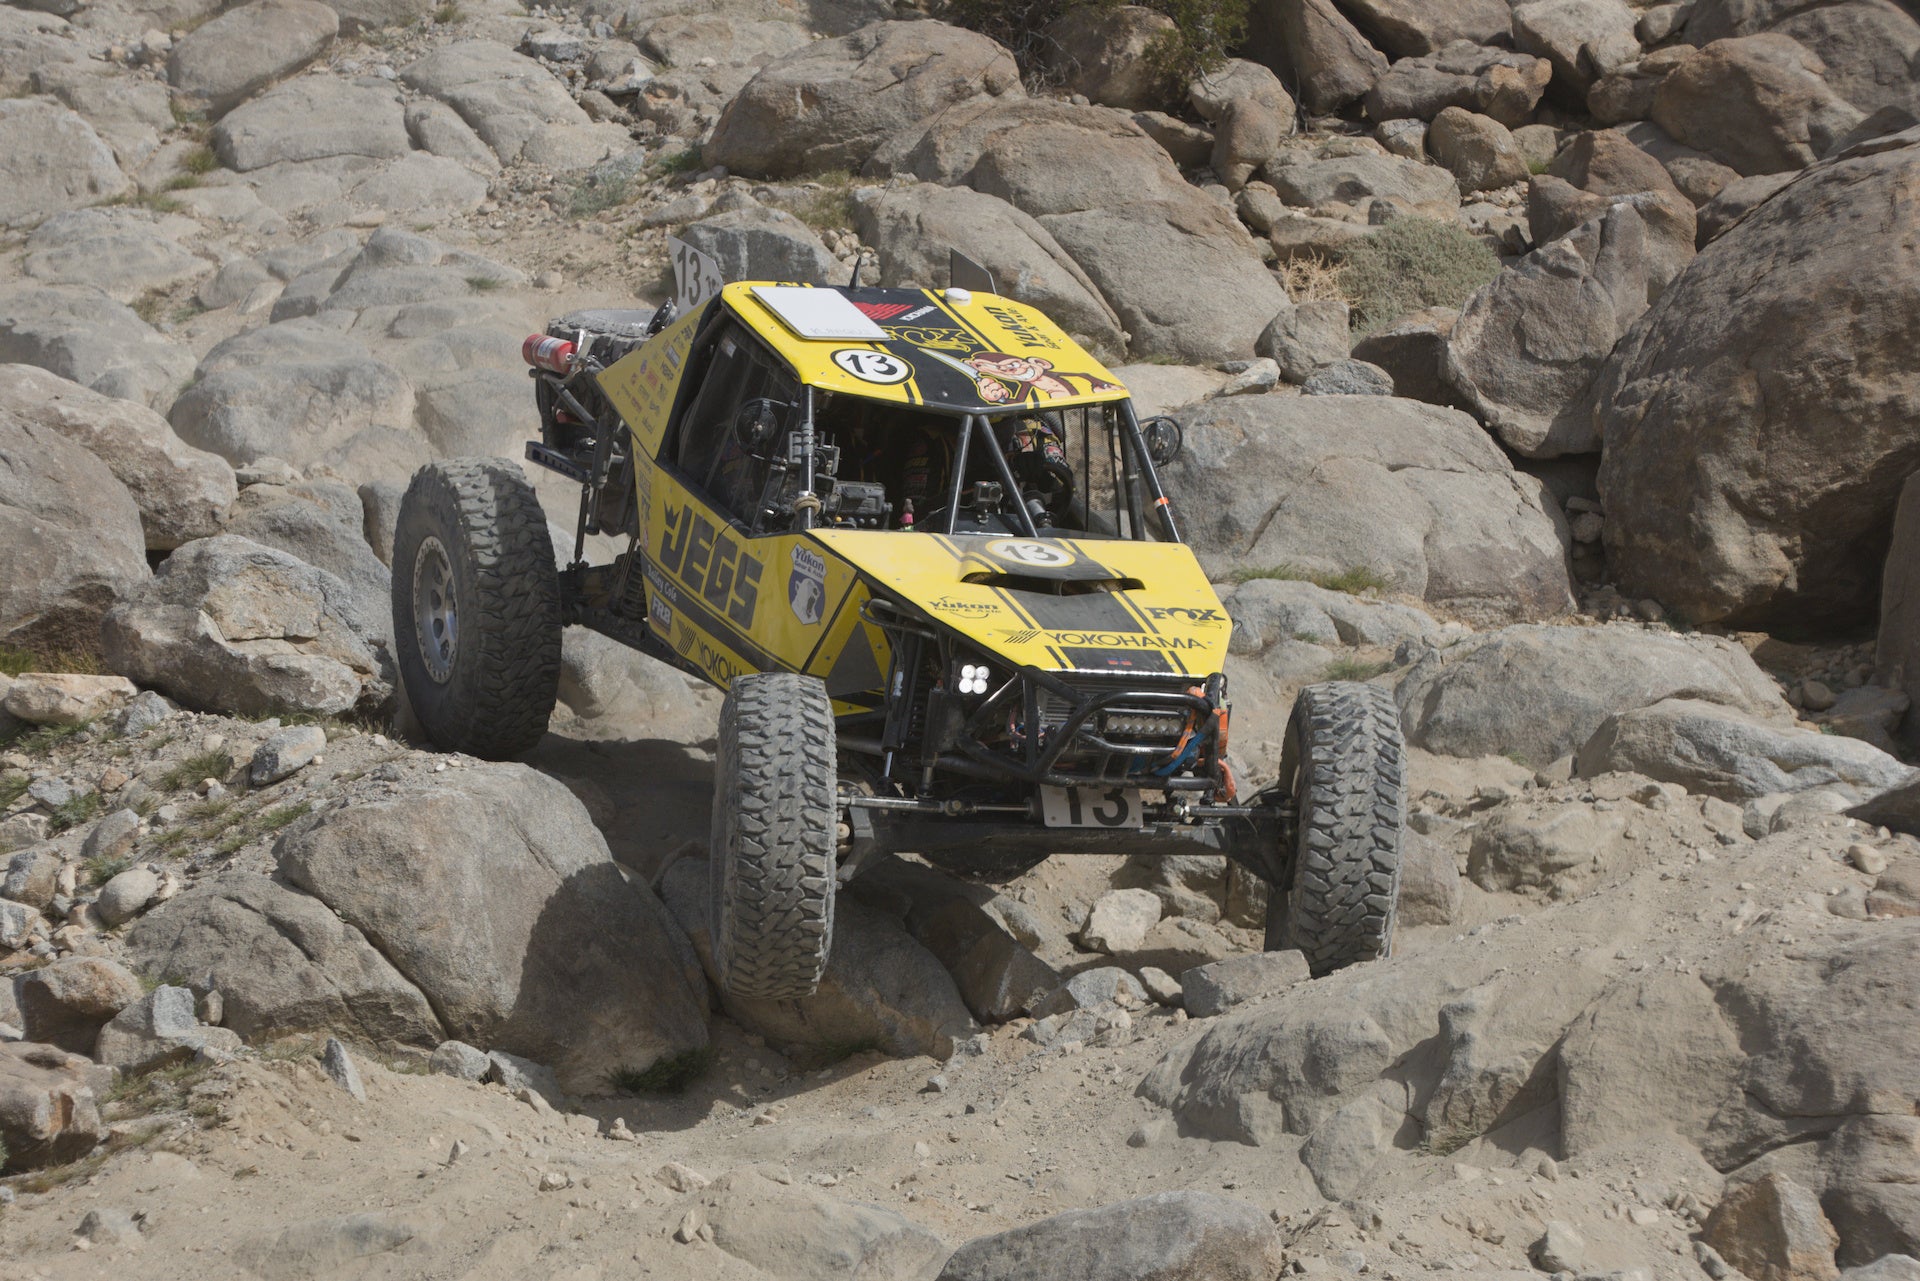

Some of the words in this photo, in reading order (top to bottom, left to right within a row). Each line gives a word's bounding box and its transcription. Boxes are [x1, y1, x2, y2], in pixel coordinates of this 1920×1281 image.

[677, 245, 701, 306] 13
[983, 306, 1045, 347] Yukon
[846, 354, 898, 376] 13
[1002, 544, 1060, 563] 13
[659, 503, 764, 631] JEGS
[927, 601, 999, 610] Yukon
[1144, 607, 1226, 627] FOX
[1043, 632, 1208, 650] YOKOHAMA
[1066, 786, 1129, 826] 13
